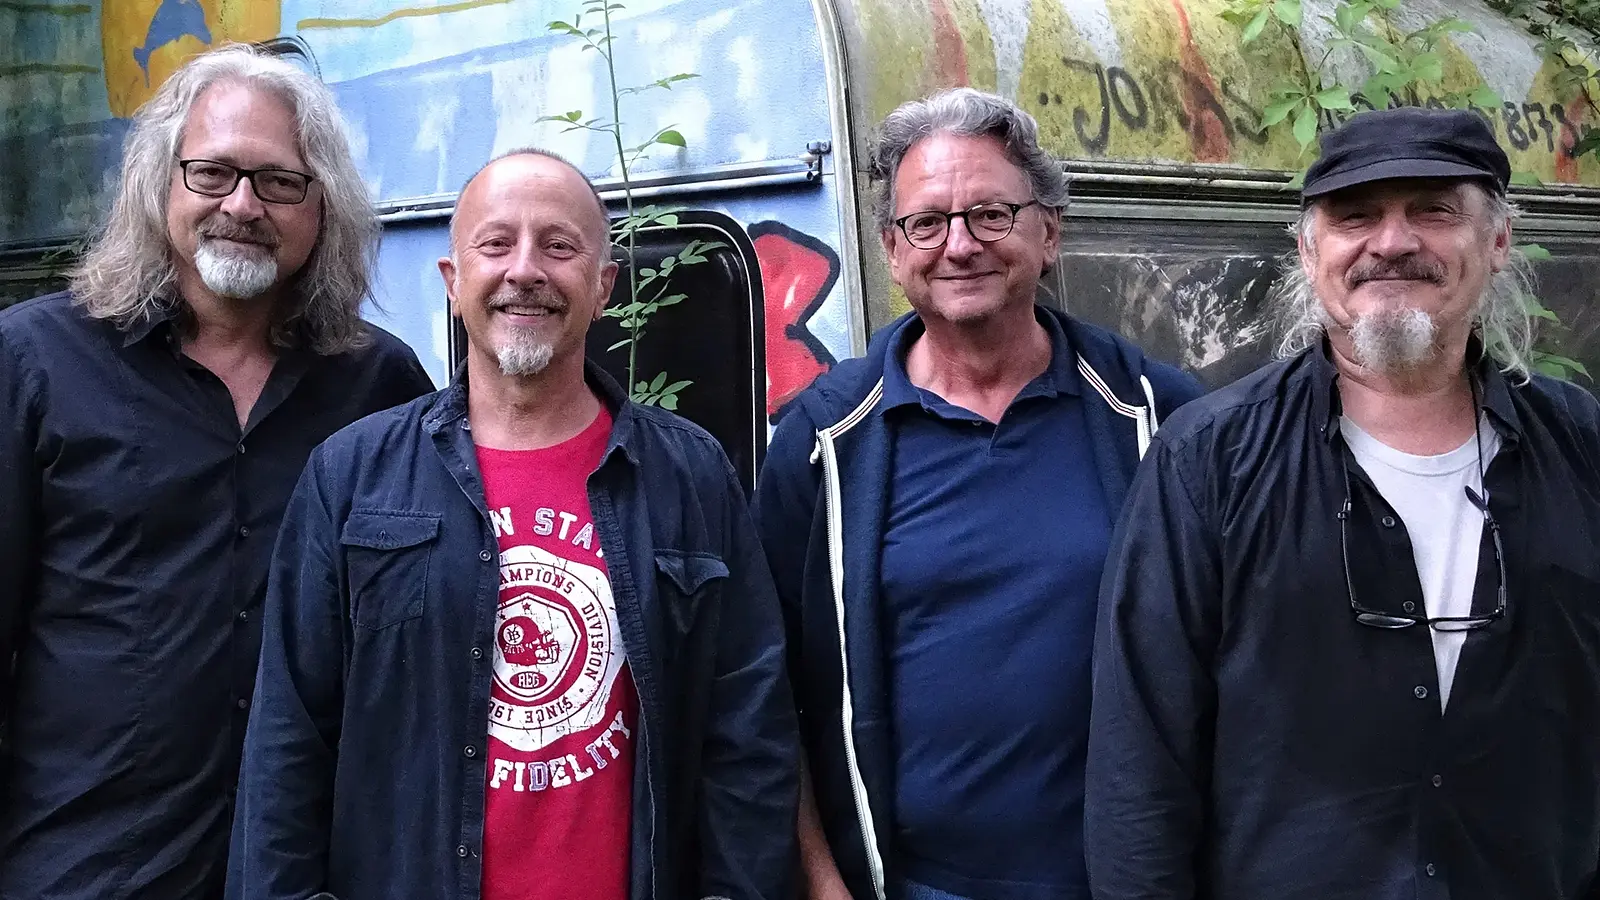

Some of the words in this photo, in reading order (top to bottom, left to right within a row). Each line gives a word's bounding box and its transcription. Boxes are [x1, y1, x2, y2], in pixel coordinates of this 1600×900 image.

[532, 507, 604, 558] STA
[581, 602, 604, 681] DIVISION
[524, 696, 574, 724] SINCE
[489, 710, 631, 792] FIDELITY
